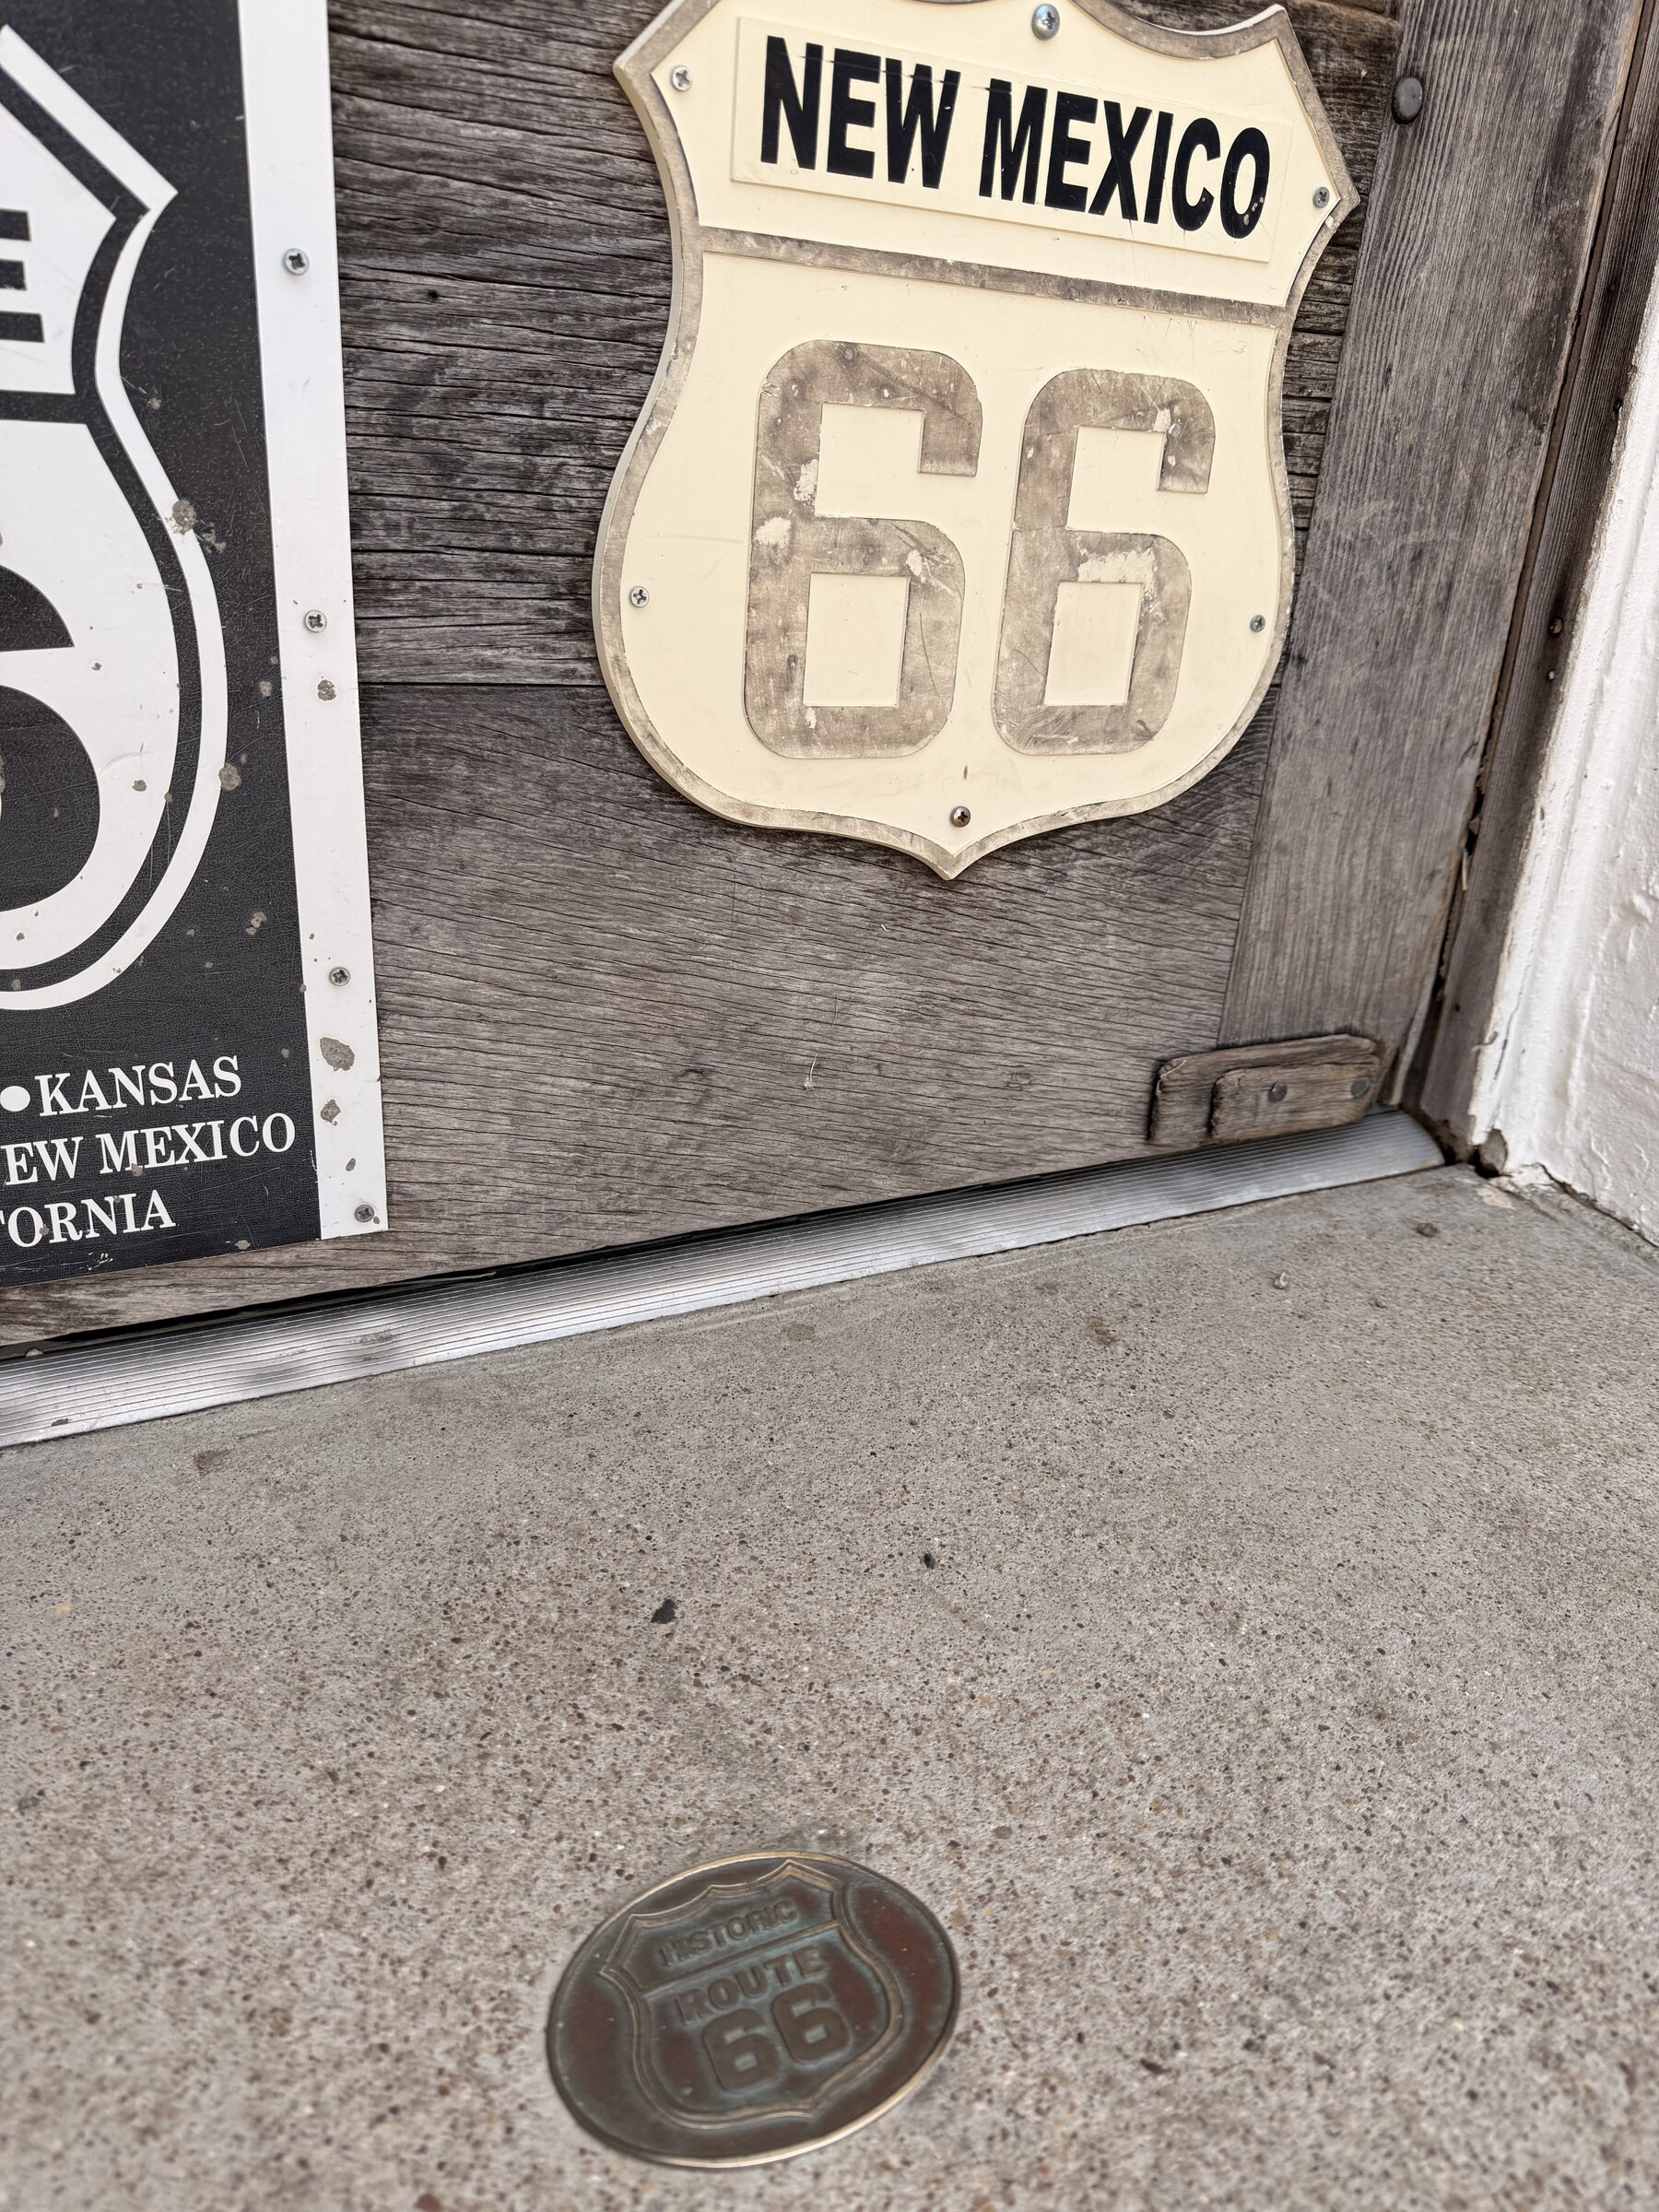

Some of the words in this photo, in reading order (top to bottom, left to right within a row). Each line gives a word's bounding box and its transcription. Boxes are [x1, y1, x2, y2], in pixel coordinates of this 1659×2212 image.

[760, 35, 960, 189] NEW
[979, 77, 1271, 240] MEXICO
[743, 339, 1216, 759] 66
[34, 1055, 242, 1117] KANSAS
[95, 1112, 296, 1174] MEXICO
[0, 1190, 176, 1248] ORNIA
[661, 1900, 798, 1967] HISTORIC
[675, 1945, 828, 2024] ROUTE
[703, 1983, 849, 2092] 66
